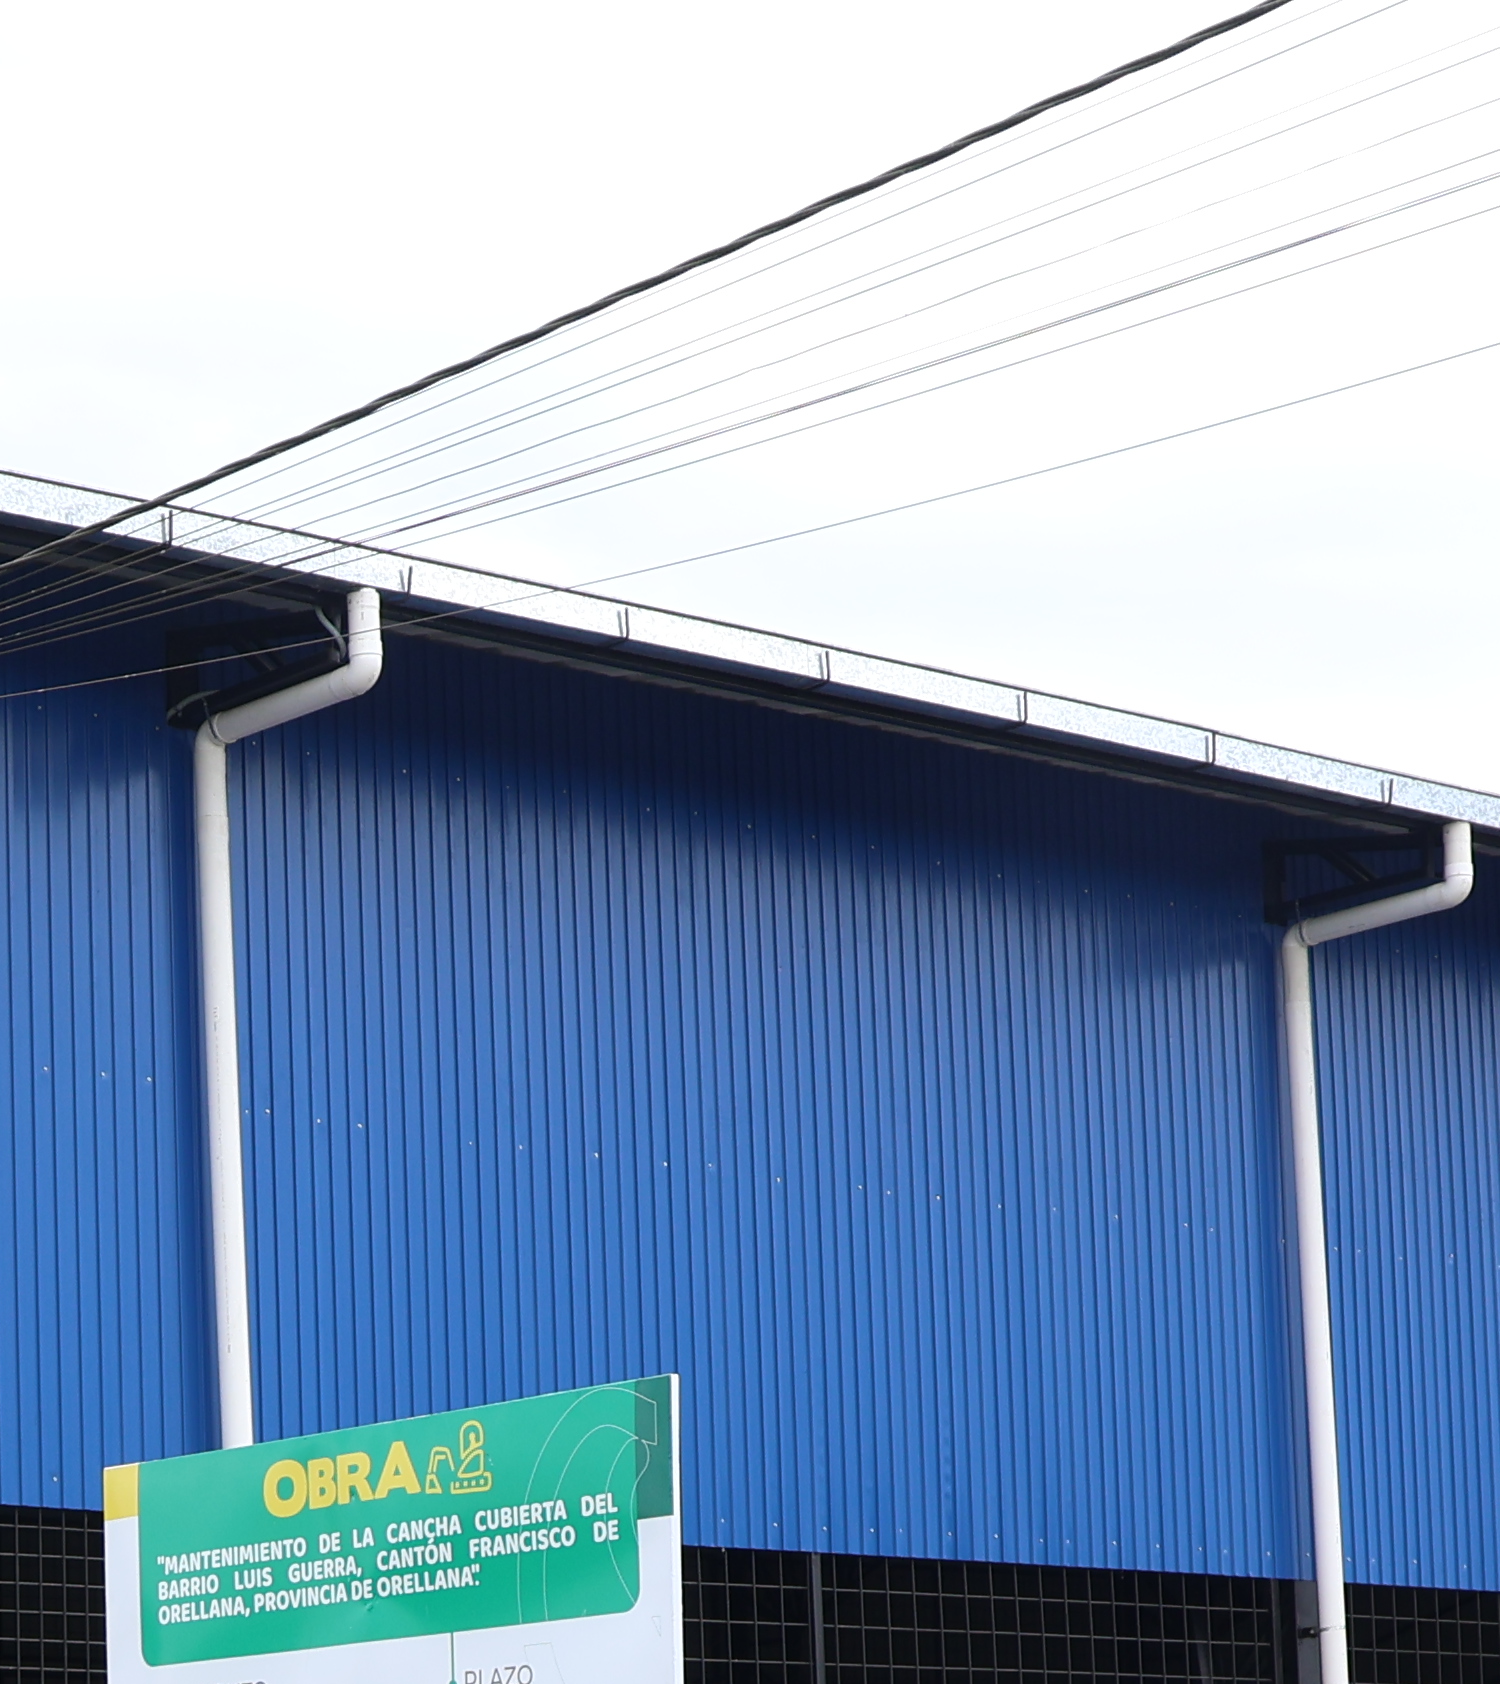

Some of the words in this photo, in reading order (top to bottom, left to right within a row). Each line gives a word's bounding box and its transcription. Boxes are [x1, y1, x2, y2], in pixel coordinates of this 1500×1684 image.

[263, 1441, 421, 1518] OBRA
[157, 1537, 307, 1575] "MANTENIMIENTO
[319, 1532, 341, 1554] DE
[353, 1527, 374, 1548] LA
[386, 1515, 462, 1544] CANCHA
[475, 1499, 567, 1531] CUBIERTA
[581, 1492, 618, 1517] DEL
[158, 1575, 219, 1600] BARRIO
[234, 1567, 273, 1590] LUIS
[288, 1555, 362, 1583] GUERRA,
[377, 1537, 452, 1571] CANTÓN
[469, 1525, 576, 1559] FRANCISCO
[593, 1520, 620, 1542] DE
[158, 1596, 250, 1625] ORELLANA,
[254, 1582, 348, 1613] PROVINCIA
[351, 1579, 373, 1601] DE
